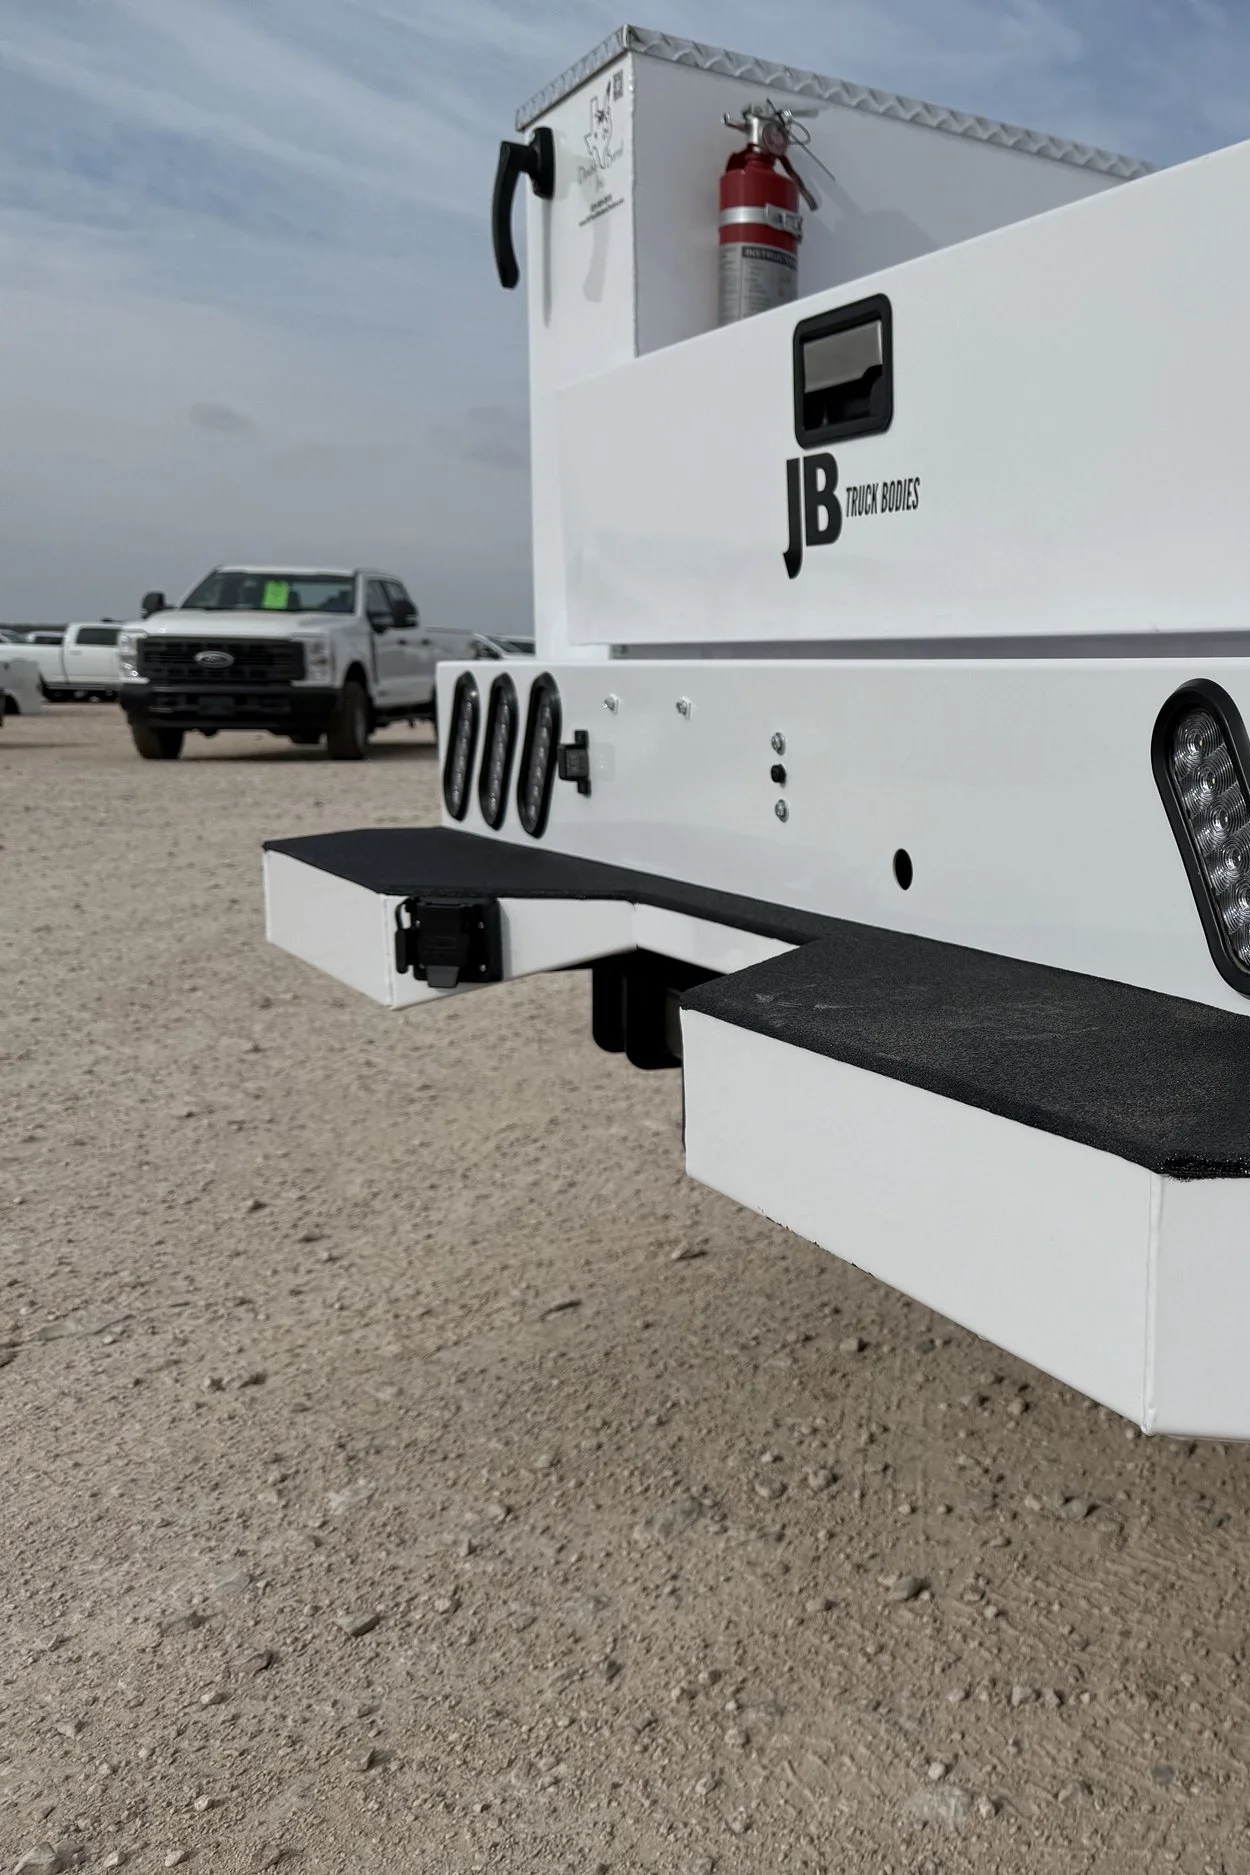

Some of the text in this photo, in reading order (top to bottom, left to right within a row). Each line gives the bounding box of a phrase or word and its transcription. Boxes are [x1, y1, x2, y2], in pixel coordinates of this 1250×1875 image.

[782, 452, 920, 579] JB TRUCK BODIES
